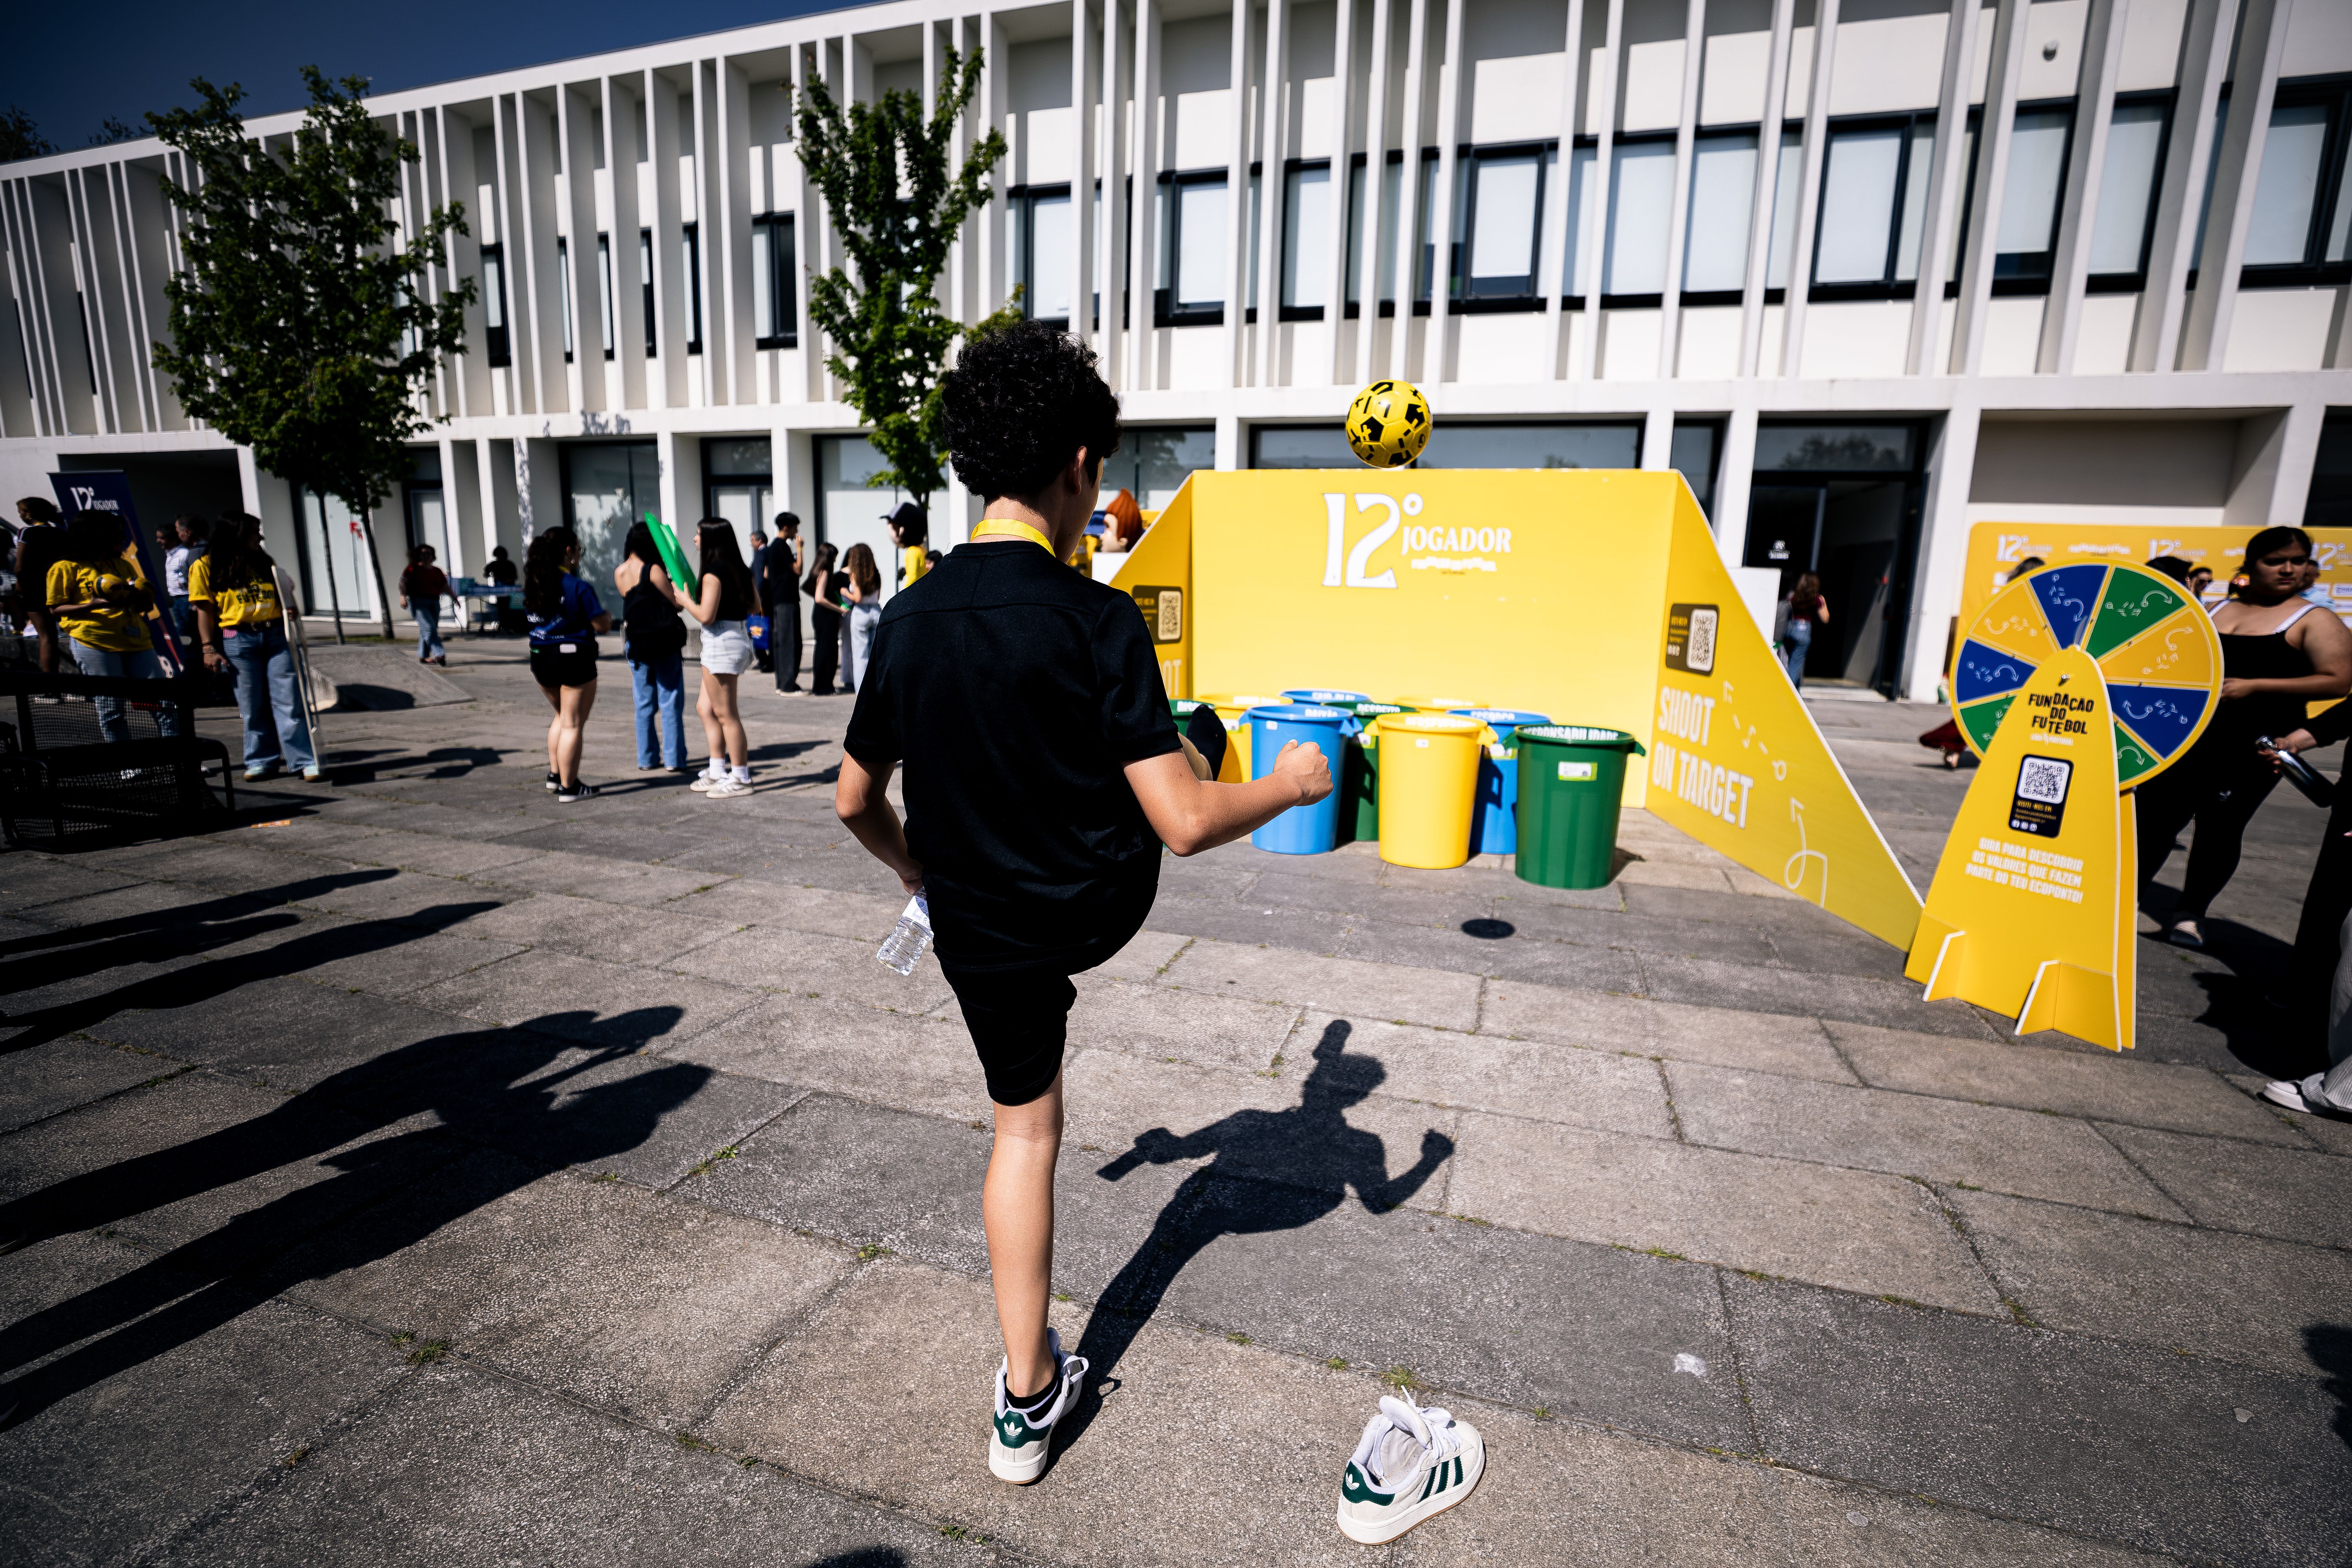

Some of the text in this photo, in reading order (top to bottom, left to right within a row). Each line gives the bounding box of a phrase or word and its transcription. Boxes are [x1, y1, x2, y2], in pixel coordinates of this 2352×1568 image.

[1401, 526, 1512, 556] JOGADOR
[1658, 686, 1715, 747] SHOOT
[2029, 692, 2094, 713] FUNDAÇÃO
[2050, 707, 2067, 720] DO
[2032, 715, 2088, 735] FUTEBOL
[1652, 741, 1754, 829] ON TARGET
[1972, 850, 2082, 888] OS VALORES QUE FAZEM
[1979, 837, 2083, 873] GIRA PARA DESCOBRIR
[1965, 863, 2083, 904] PARTE DO TEU ECOPONTO!
